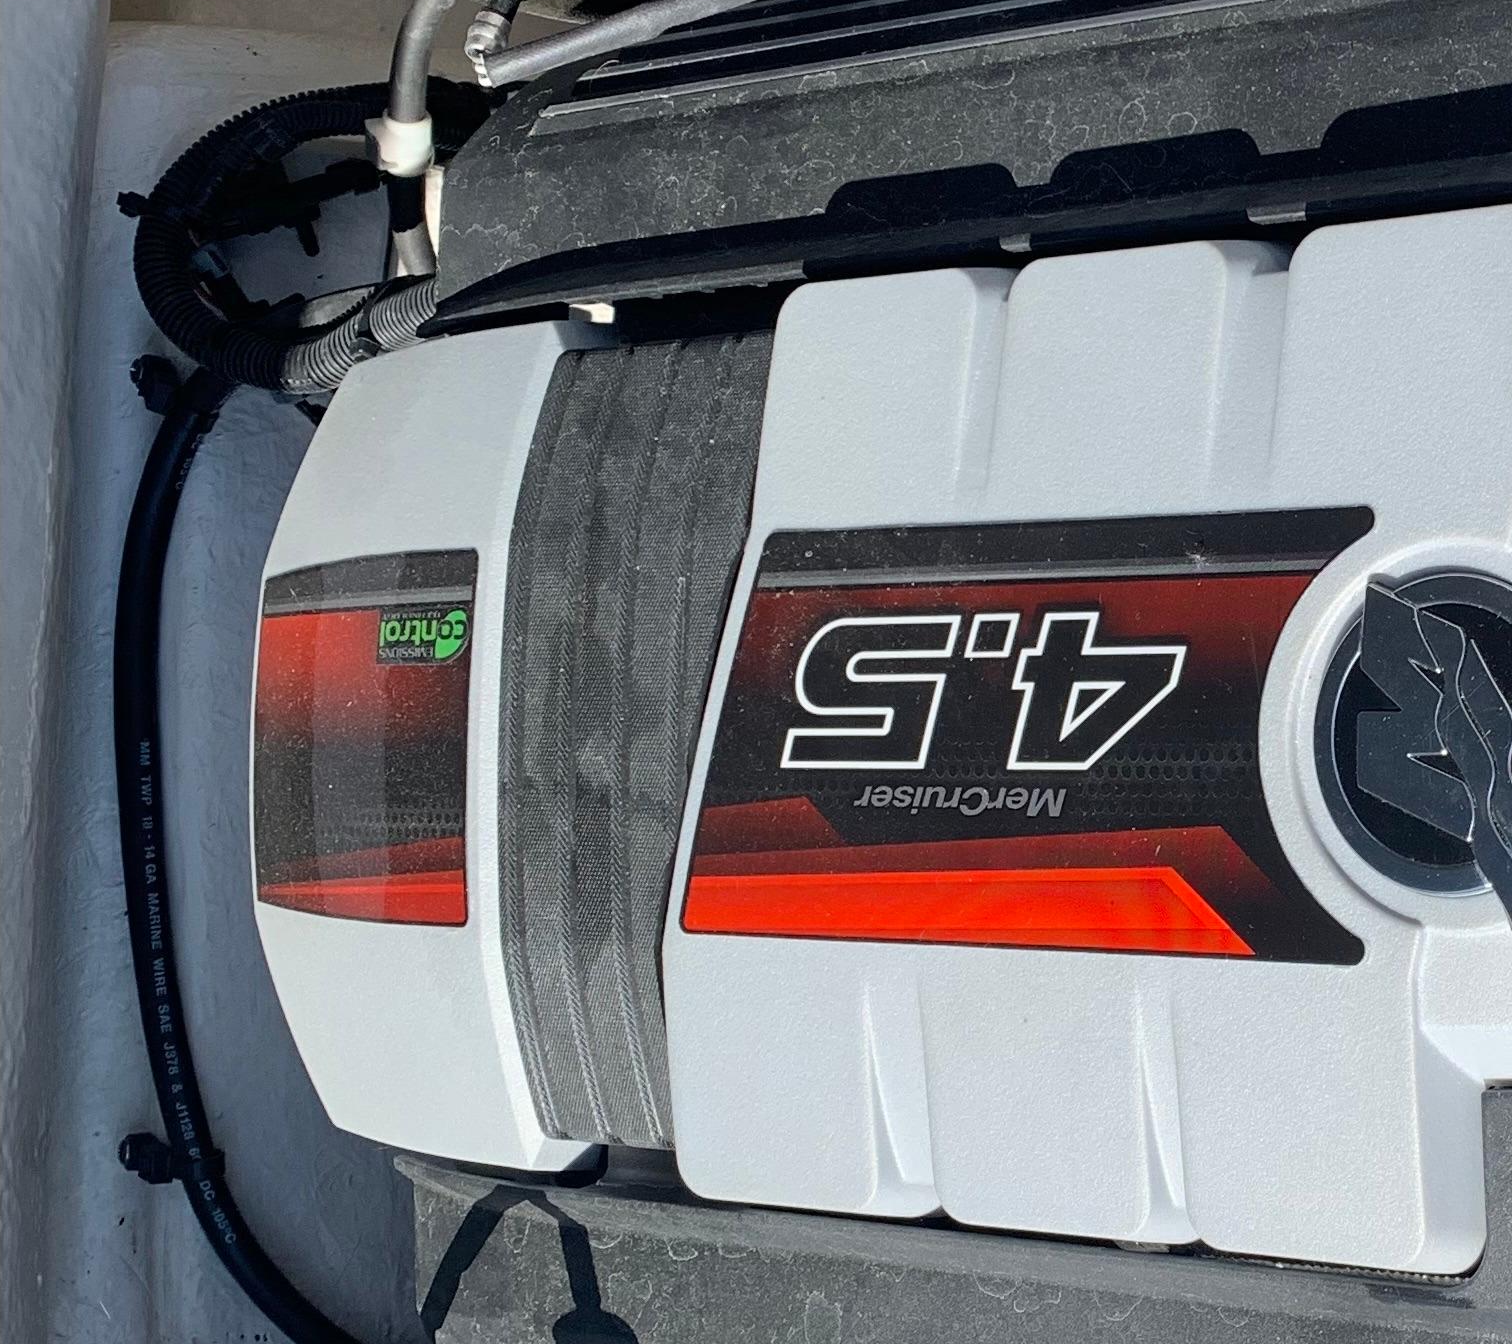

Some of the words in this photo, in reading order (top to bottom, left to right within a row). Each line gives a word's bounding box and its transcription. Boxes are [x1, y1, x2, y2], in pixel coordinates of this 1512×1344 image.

[379, 619, 468, 646] control
[777, 606, 1188, 770] 4.5
[854, 782, 1068, 816] MerCruiser
[145, 864, 157, 884] GA
[147, 893, 162, 949] MARINE
[153, 958, 168, 996] WIRE
[158, 1004, 172, 1033] SAE
[199, 1180, 215, 1201] DC
